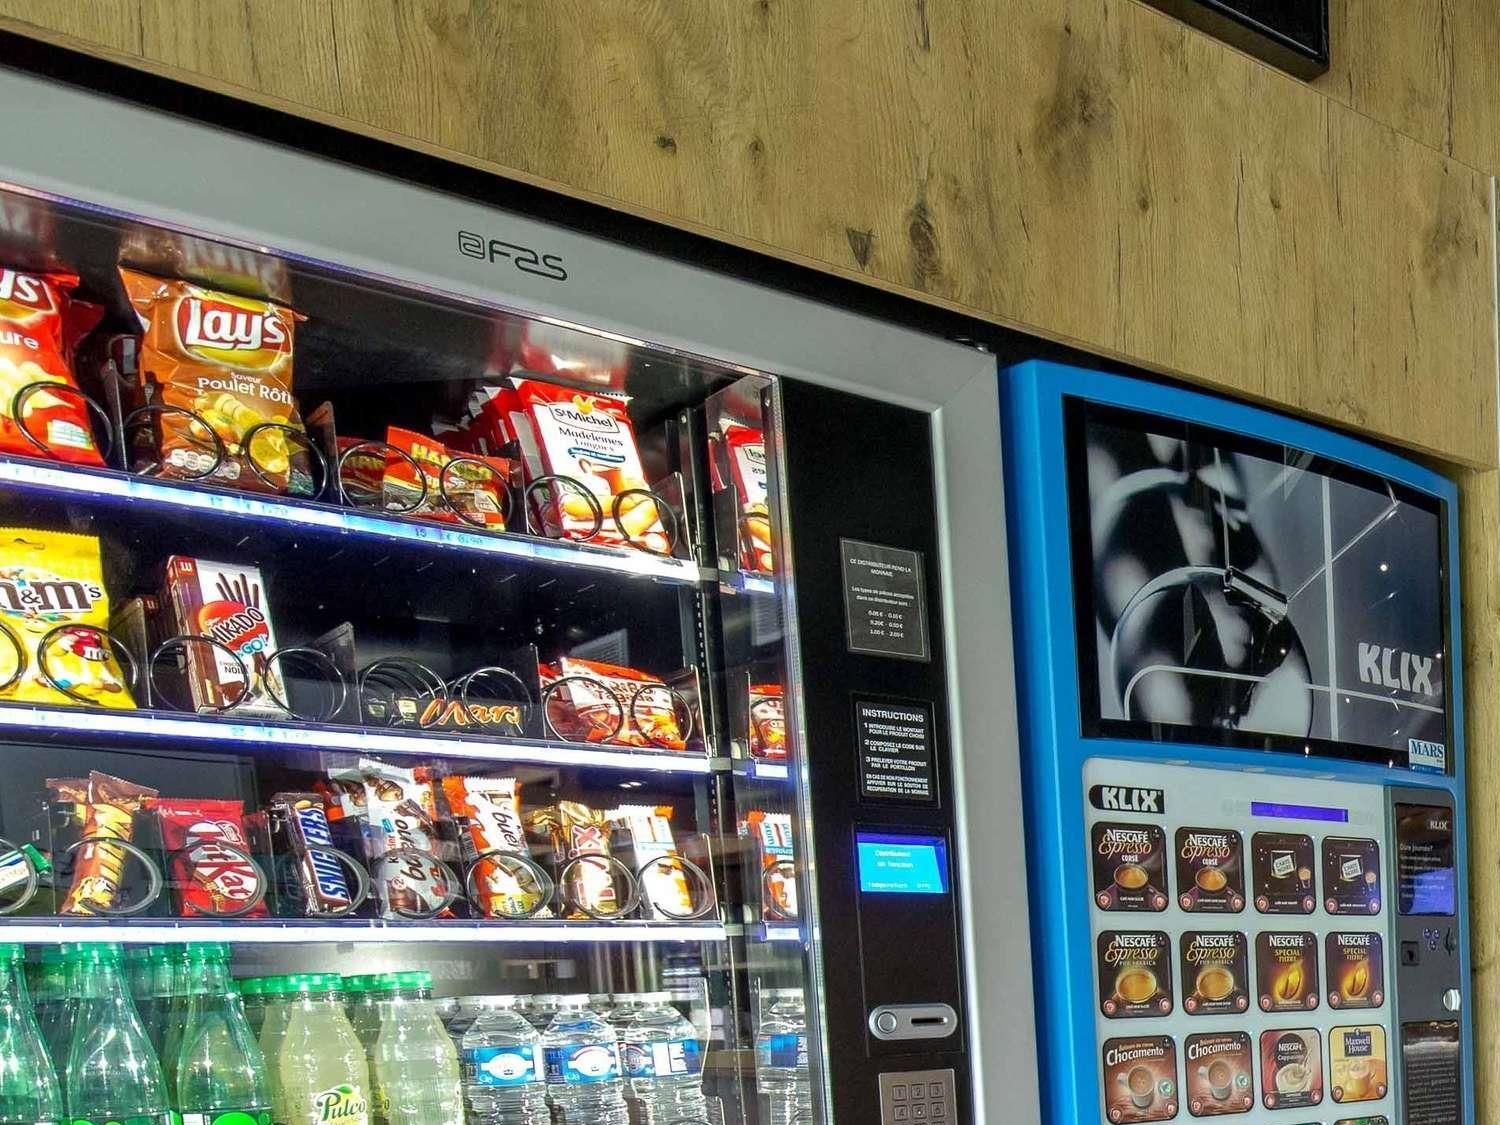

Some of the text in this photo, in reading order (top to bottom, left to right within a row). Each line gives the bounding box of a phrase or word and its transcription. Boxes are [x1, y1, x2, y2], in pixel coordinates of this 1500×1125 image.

[185, 298, 287, 350] Lay's
[198, 376, 254, 398] Poulet
[567, 410, 614, 428] Michel
[202, 605, 265, 644] MIKADO
[1358, 643, 1434, 696] KLIX
[419, 698, 521, 728] Mars
[862, 708, 925, 723] INSTRUCTIONS
[1411, 740, 1444, 758] MARS
[1102, 786, 1158, 812] KLIX
[1107, 829, 1149, 843] NESCAFÉ
[1189, 834, 1228, 847] NESCAFÉ
[1098, 834, 1153, 860] Espresso
[1181, 839, 1231, 864] Espresso
[1115, 935, 1157, 947] NESCAFÉ
[1196, 935, 1235, 947] NESCAFÉ
[1269, 935, 1304, 947] NESCAFÉ
[1337, 935, 1371, 946] NESCAFÉ
[1105, 941, 1158, 967] Espresso
[1186, 941, 1235, 967] Espresso
[1188, 1040, 1241, 1060] Chocamento
[1345, 1036, 1371, 1046] Maxwell
[1348, 1045, 1368, 1054] House
[1106, 1047, 1164, 1067] Chocamento
[316, 1091, 367, 1122] Pulco
